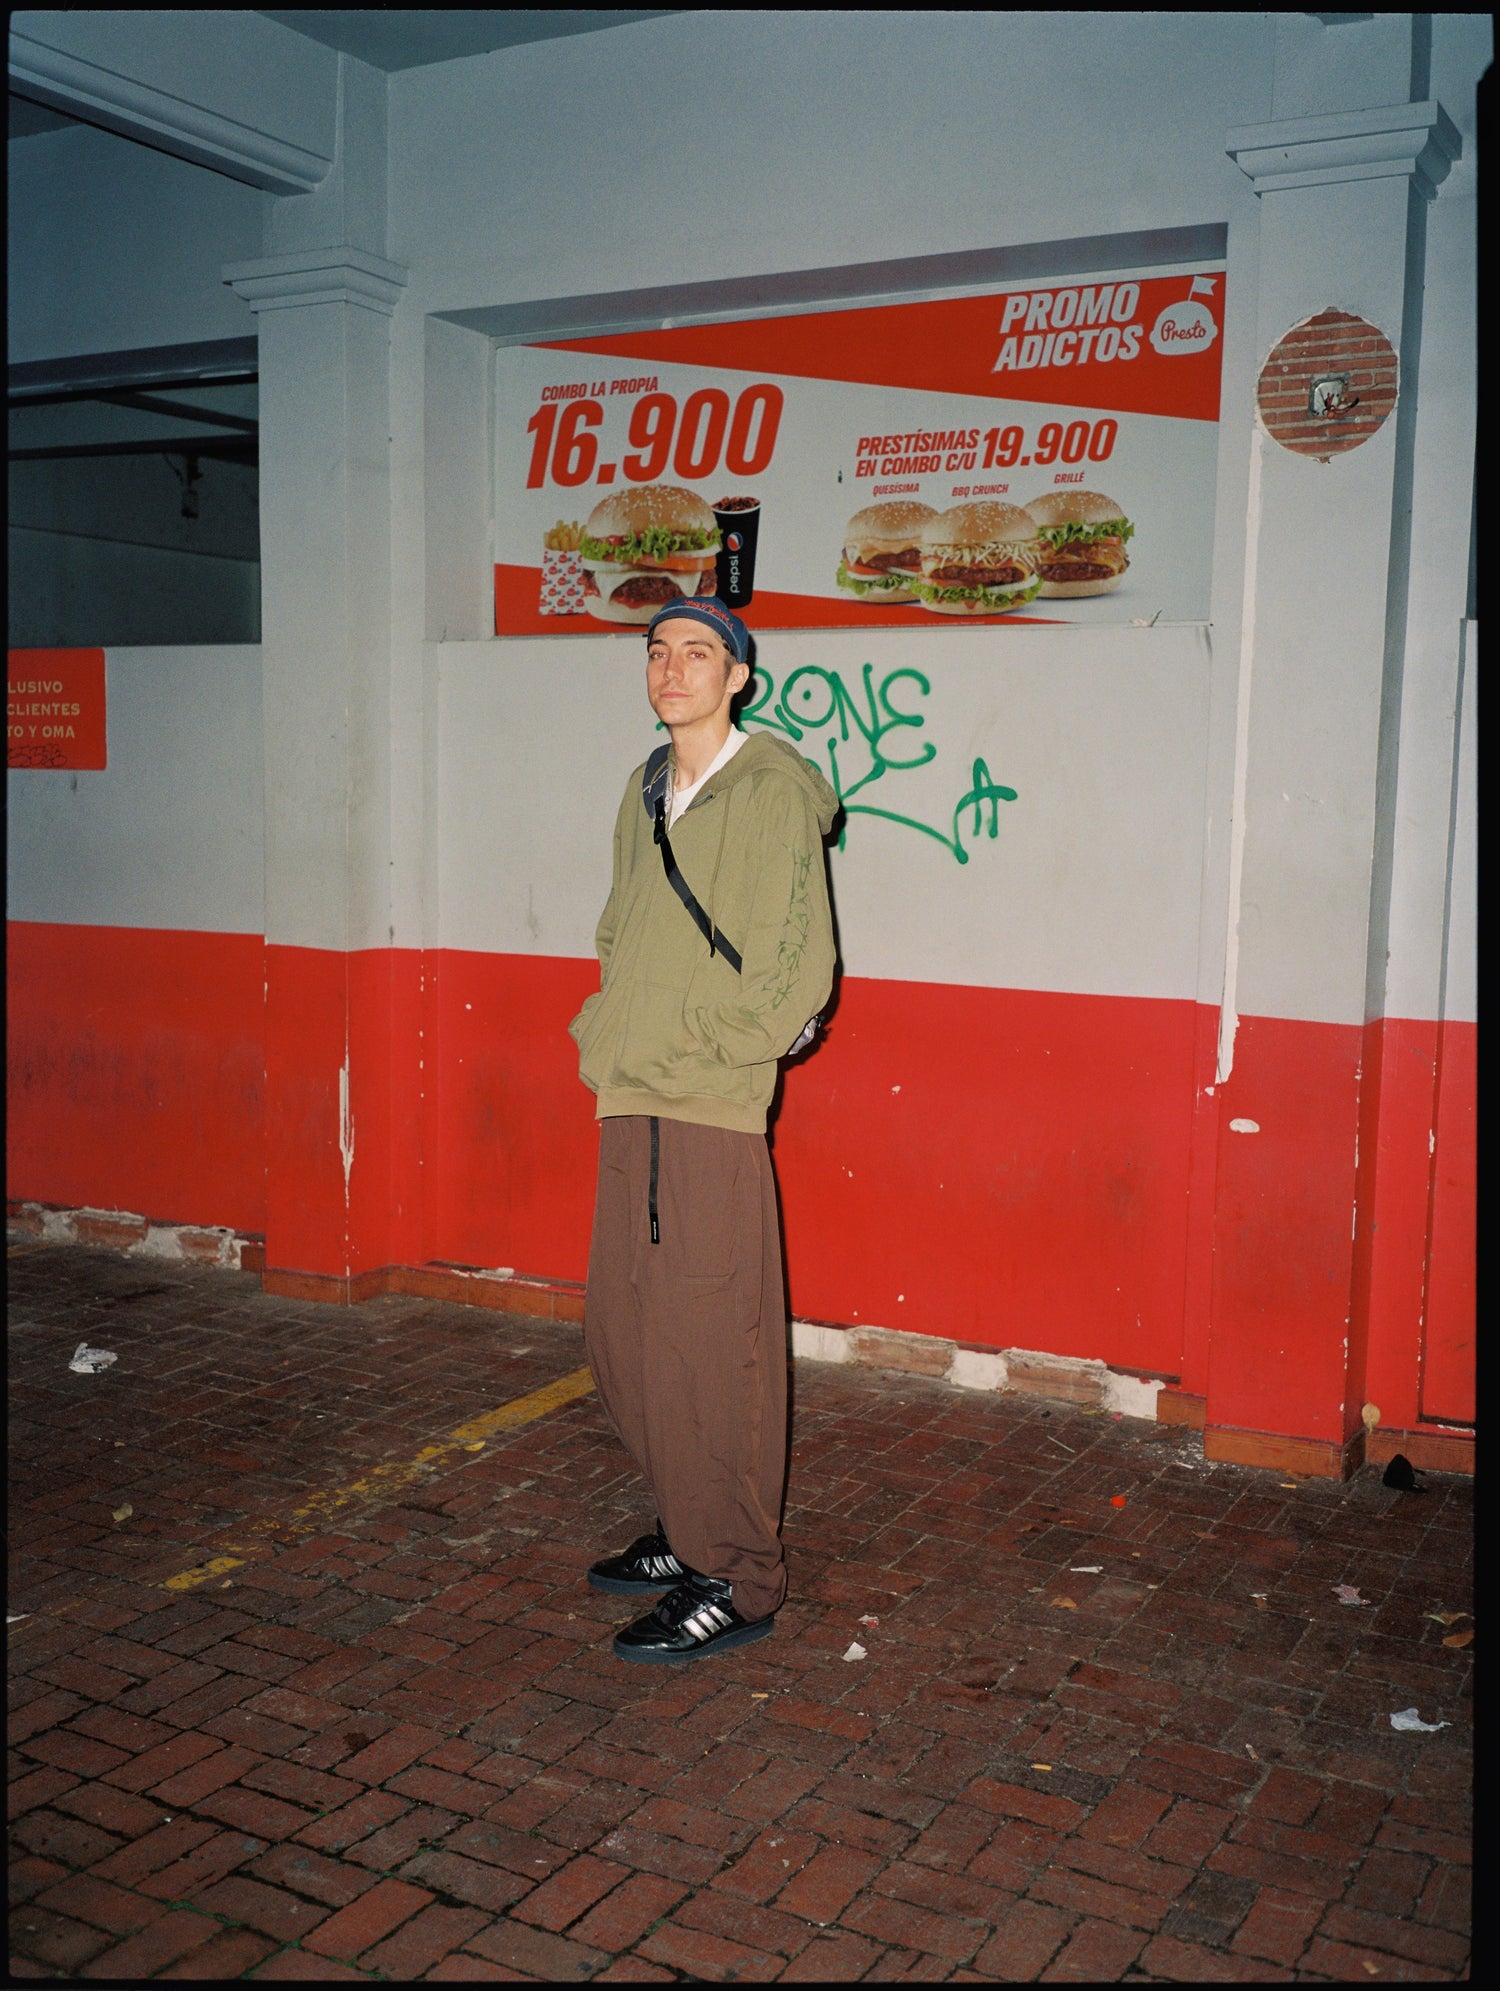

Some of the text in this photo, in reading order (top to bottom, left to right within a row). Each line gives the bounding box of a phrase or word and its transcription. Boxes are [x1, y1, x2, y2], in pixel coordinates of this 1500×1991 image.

[1000, 283, 1142, 334] PROMO
[1160, 319, 1207, 342] Presto
[991, 324, 1144, 374] ADICTOS
[541, 376, 659, 402] COMBO LA PROPIA
[526, 383, 784, 489] 16.900
[855, 428, 981, 457] PRESTÍSIMAS
[982, 419, 1118, 469] 19.900
[855, 452, 977, 478] EN COMBO C/U
[1053, 471, 1085, 484] GRILLÉ
[872, 483, 920, 497] QUESÍSIMA
[951, 484, 1009, 498] BBQ CRUNCH
[728, 555, 741, 594] pepsi
[6, 703, 80, 716] CLIENTES
[28, 725, 37, 738] Y
[42, 725, 75, 738] OMA
